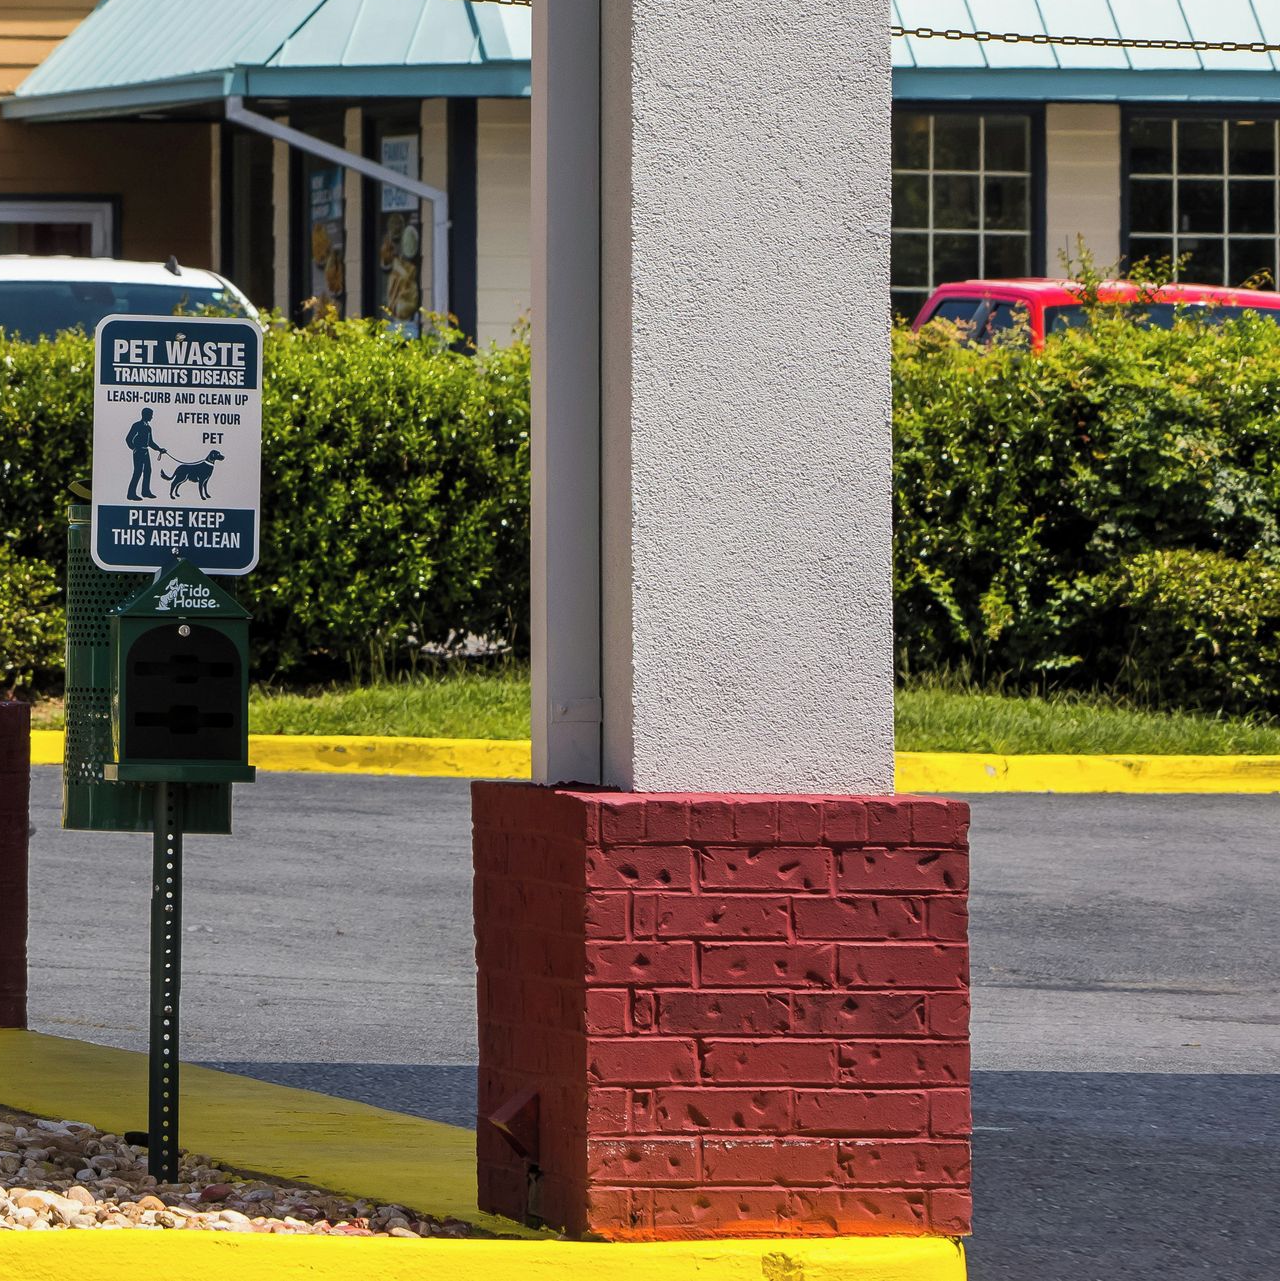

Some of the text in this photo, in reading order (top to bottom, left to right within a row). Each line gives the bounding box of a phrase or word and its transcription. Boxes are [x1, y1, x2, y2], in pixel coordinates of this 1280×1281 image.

[113, 339, 246, 367] PET WASTE
[113, 367, 245, 386] TRANSMITS DISEASE
[107, 390, 249, 406] LEASH-CURB AND CLEAN UP
[176, 412, 241, 425] AFTER YOUR
[202, 432, 224, 444] PET
[128, 509, 225, 528] PLEASE KEEP
[111, 528, 241, 549] THIS AREA CLEAN
[180, 583, 210, 597] Fido
